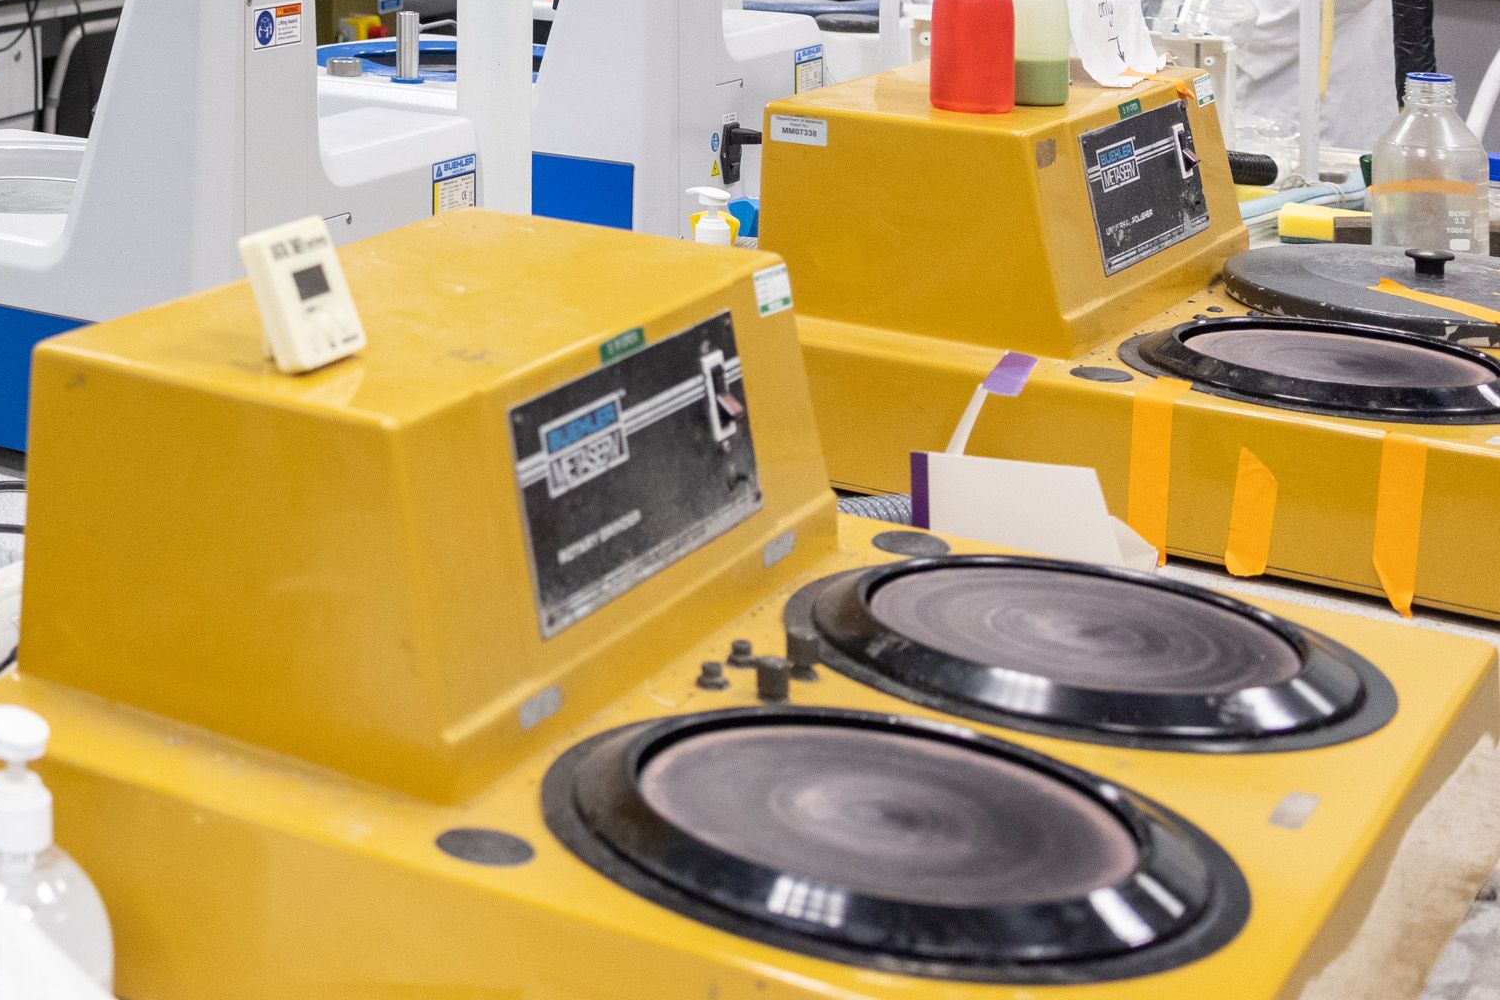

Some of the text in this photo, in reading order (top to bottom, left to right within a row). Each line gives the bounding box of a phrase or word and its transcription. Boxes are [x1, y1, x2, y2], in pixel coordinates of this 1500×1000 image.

[781, 127, 817, 138] MM07338
[1100, 141, 1133, 165] BUEHLER
[443, 157, 474, 172] BUEHLER
[1103, 161, 1139, 188] METASERV
